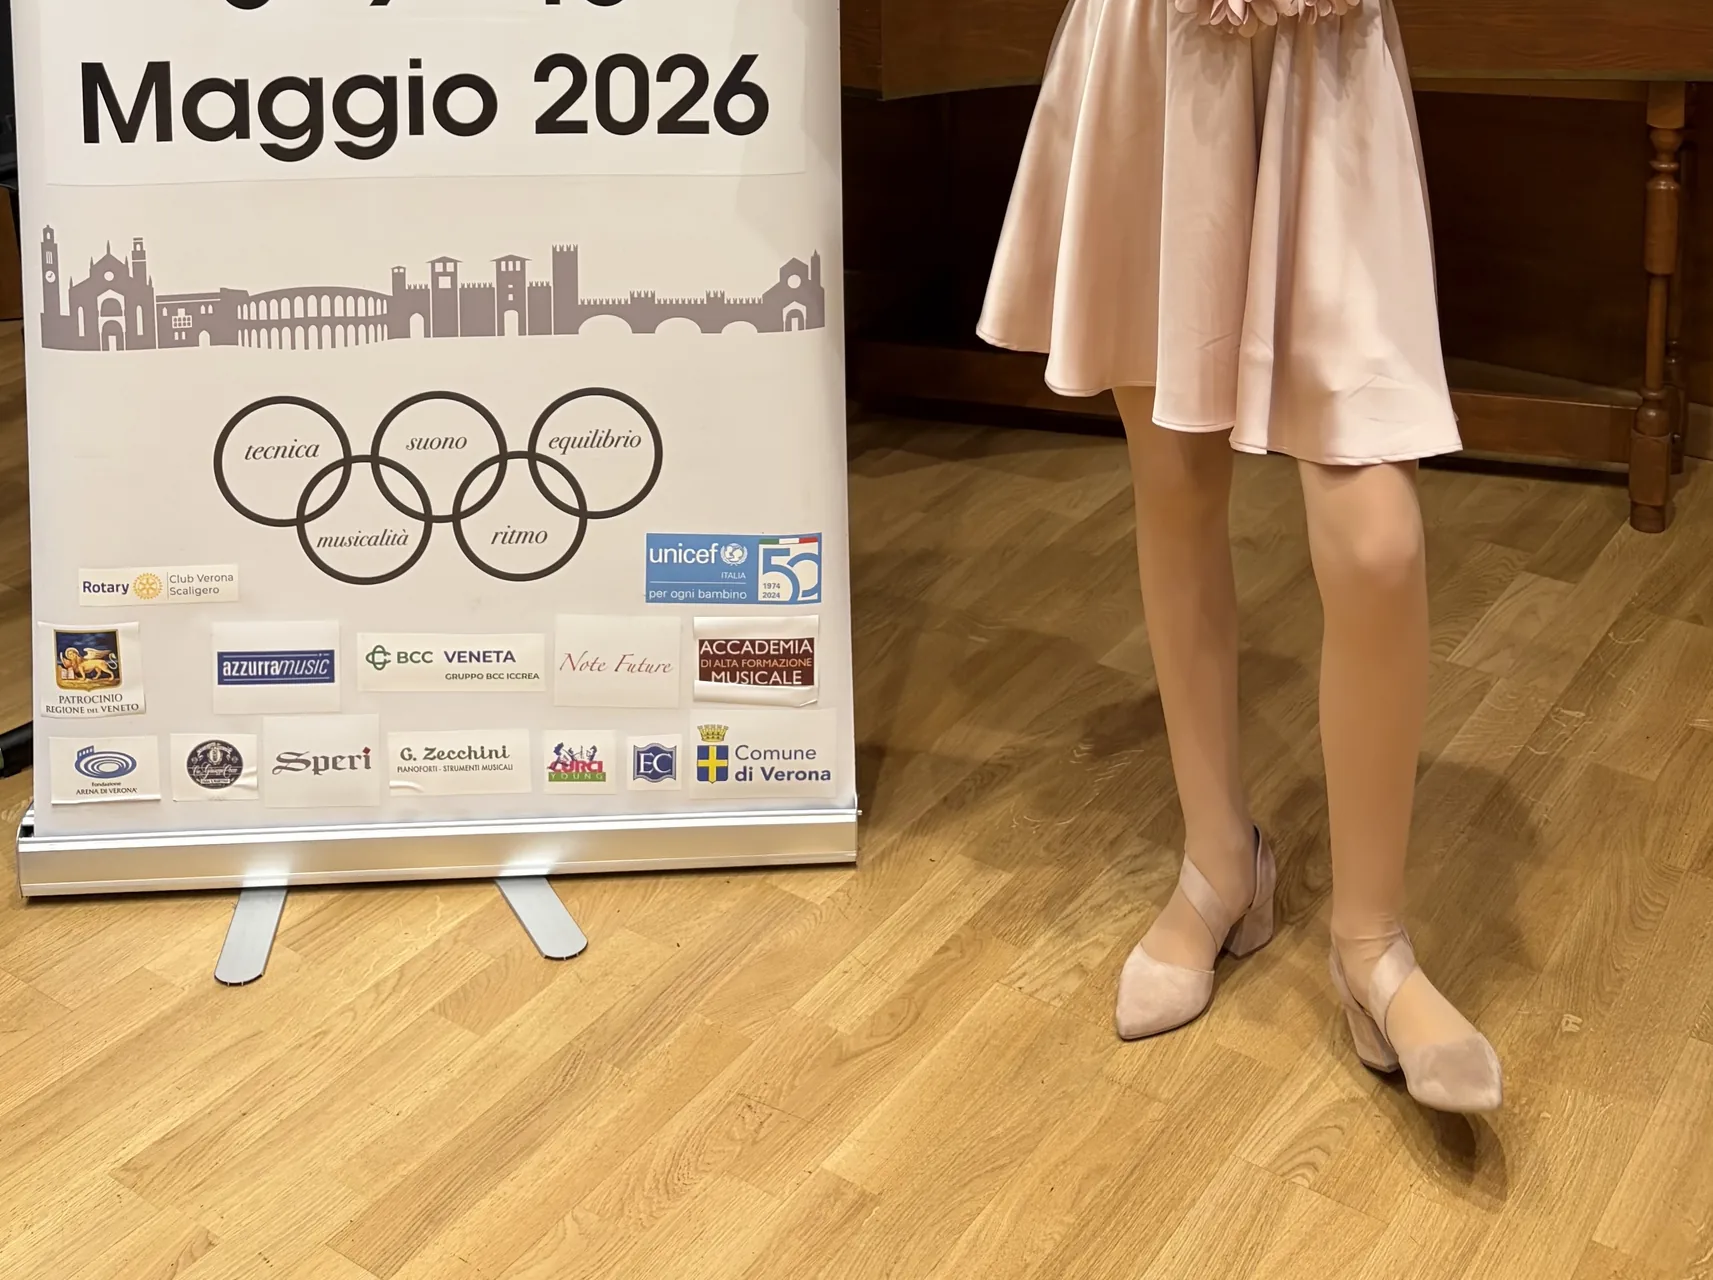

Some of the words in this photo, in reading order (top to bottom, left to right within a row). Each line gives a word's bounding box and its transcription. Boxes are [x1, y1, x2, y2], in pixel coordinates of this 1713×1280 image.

[80, 57, 498, 162] Maggio
[534, 52, 770, 136] 2026
[244, 439, 320, 461] tecnica
[405, 435, 468, 452] suono
[548, 429, 642, 456] equilibrio
[316, 528, 409, 549] musicalità
[491, 525, 548, 545] ritmo
[649, 543, 718, 564] unicef
[169, 573, 193, 584] Club
[196, 571, 234, 583] Verona
[82, 580, 130, 596] Rotary
[169, 584, 220, 598] Scaligero
[649, 590, 668, 600] per
[671, 589, 695, 600] ogni
[699, 589, 747, 600] bambino
[700, 639, 813, 656] ACCADEMIA
[222, 653, 331, 677] azzurramusic
[397, 650, 434, 664] BCC
[444, 650, 516, 663] VENETA
[559, 650, 608, 674] Note
[614, 654, 674, 675] Future
[700, 659, 712, 668] DI
[713, 659, 738, 668] ALTA
[741, 657, 812, 668] FORMAZIONE
[445, 672, 484, 681] GRUPPO
[486, 672, 505, 680] BCC
[506, 671, 540, 680] ICCREA
[711, 670, 802, 685] MUSICALE
[59, 693, 123, 704] PATROCINIO
[46, 705, 85, 714] REGIONE
[100, 703, 139, 713] VENETO
[271, 746, 372, 776] Speri
[400, 747, 417, 761] G.
[422, 745, 511, 761] Zecchini
[735, 745, 817, 762] Comune
[397, 765, 438, 773] PIANOFORTI
[443, 764, 480, 772] STRUMENTI
[639, 752, 673, 774] EC
[735, 766, 758, 782] di
[760, 767, 831, 782] Verona
